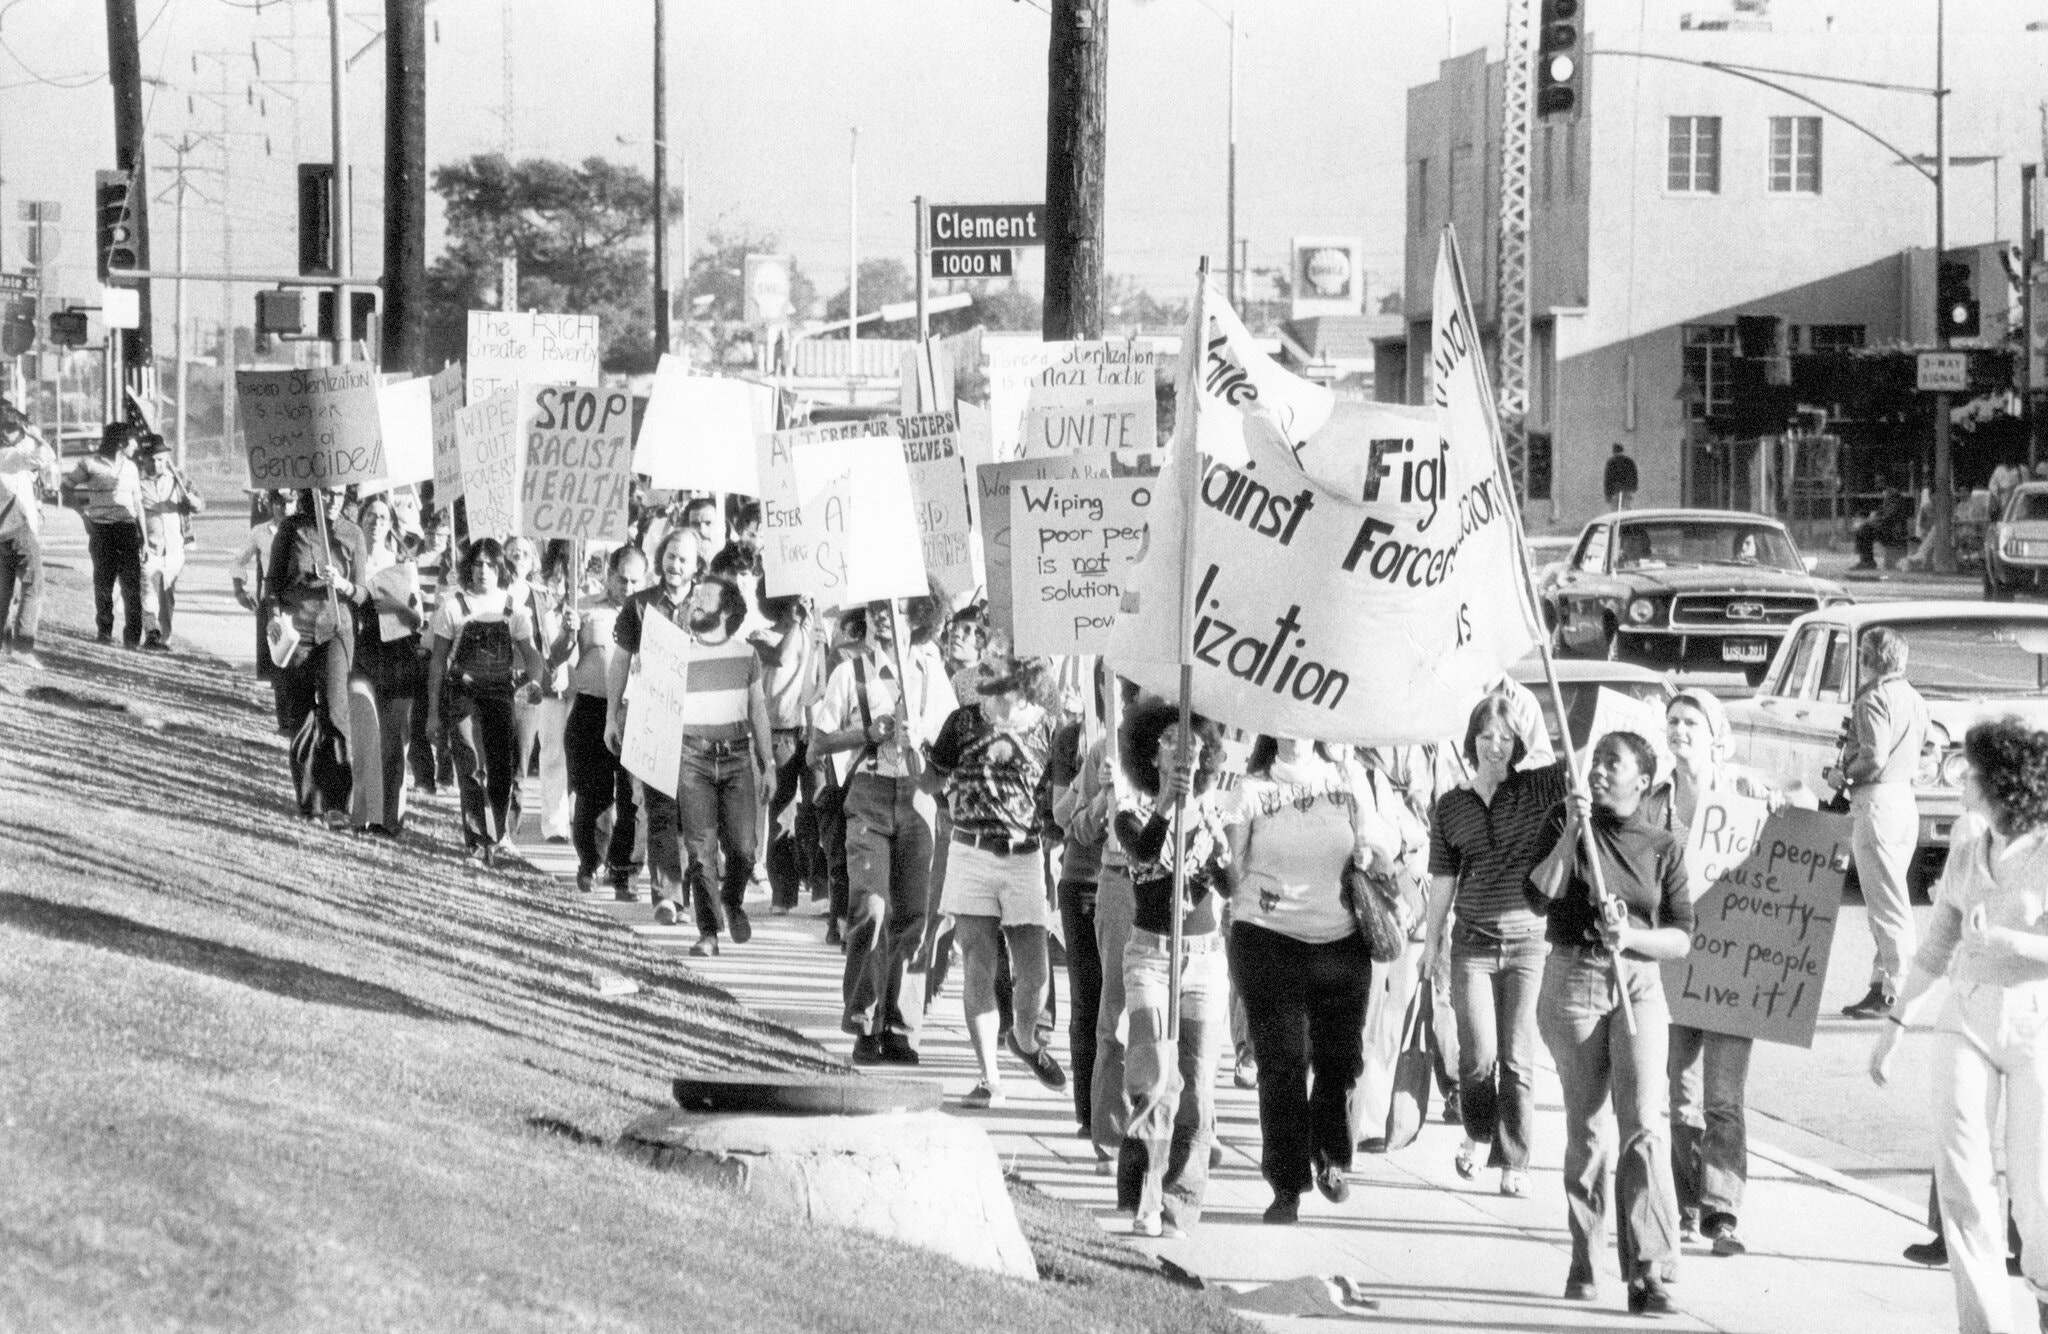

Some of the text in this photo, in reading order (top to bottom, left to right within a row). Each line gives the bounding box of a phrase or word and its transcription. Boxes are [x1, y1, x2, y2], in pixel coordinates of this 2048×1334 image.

[936, 211, 1037, 239] Clement
[942, 254, 1001, 274] 1000 N
[473, 312, 510, 337] The
[469, 336, 600, 373] Create Poverty
[1061, 339, 1155, 364] Sterilization
[1097, 364, 1147, 385] tactic
[461, 400, 515, 437] WIPE
[535, 388, 627, 434] STOP
[896, 412, 955, 440] SISTERS
[476, 432, 510, 464] OUT
[1045, 413, 1136, 449] UNITE
[526, 432, 625, 471] RACIST
[464, 454, 517, 494] POVERT
[521, 469, 626, 510] HEALTH
[765, 500, 802, 528] ESTER
[1021, 483, 1104, 521] Wiping
[1200, 450, 1314, 546] ainst
[533, 503, 618, 540] CARE
[1038, 527, 1093, 553] poor
[1037, 552, 1111, 575] is not
[1041, 579, 1120, 602] solution
[1074, 615, 1115, 640] pov
[1193, 563, 1350, 710] lization
[1700, 804, 1848, 883] Rich people
[1704, 863, 1781, 893] cause
[1693, 914, 1817, 983] oor people
[1682, 963, 1804, 1018] Live it!
